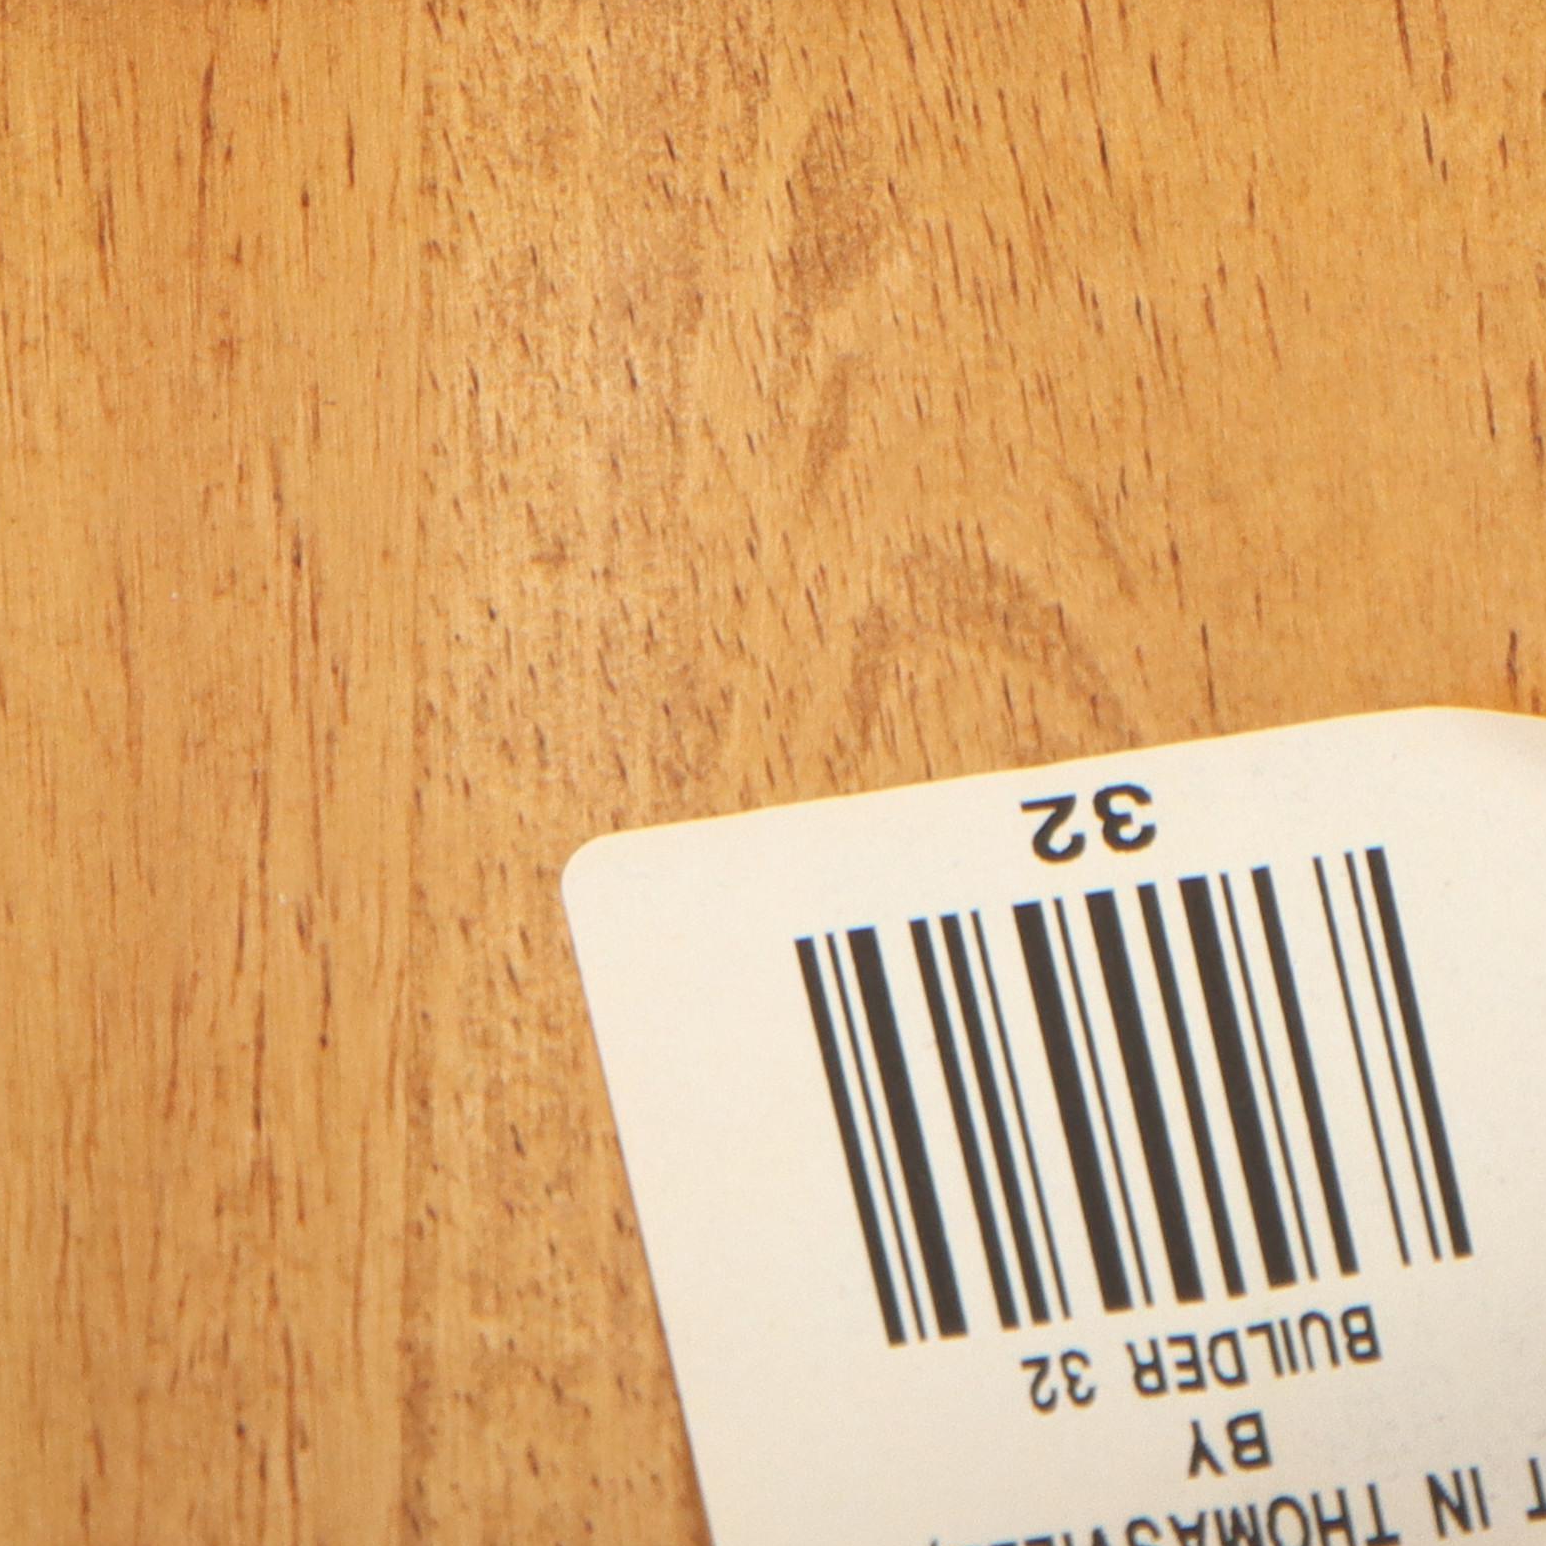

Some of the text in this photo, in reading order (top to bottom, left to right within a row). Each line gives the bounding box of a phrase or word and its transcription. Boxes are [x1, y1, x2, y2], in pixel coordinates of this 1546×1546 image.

[1020, 780, 1158, 865] 32
[1021, 1303, 1383, 1413] BUILDER 32
[1183, 1410, 1273, 1480] BY
[1428, 1466, 1491, 1539] IN
